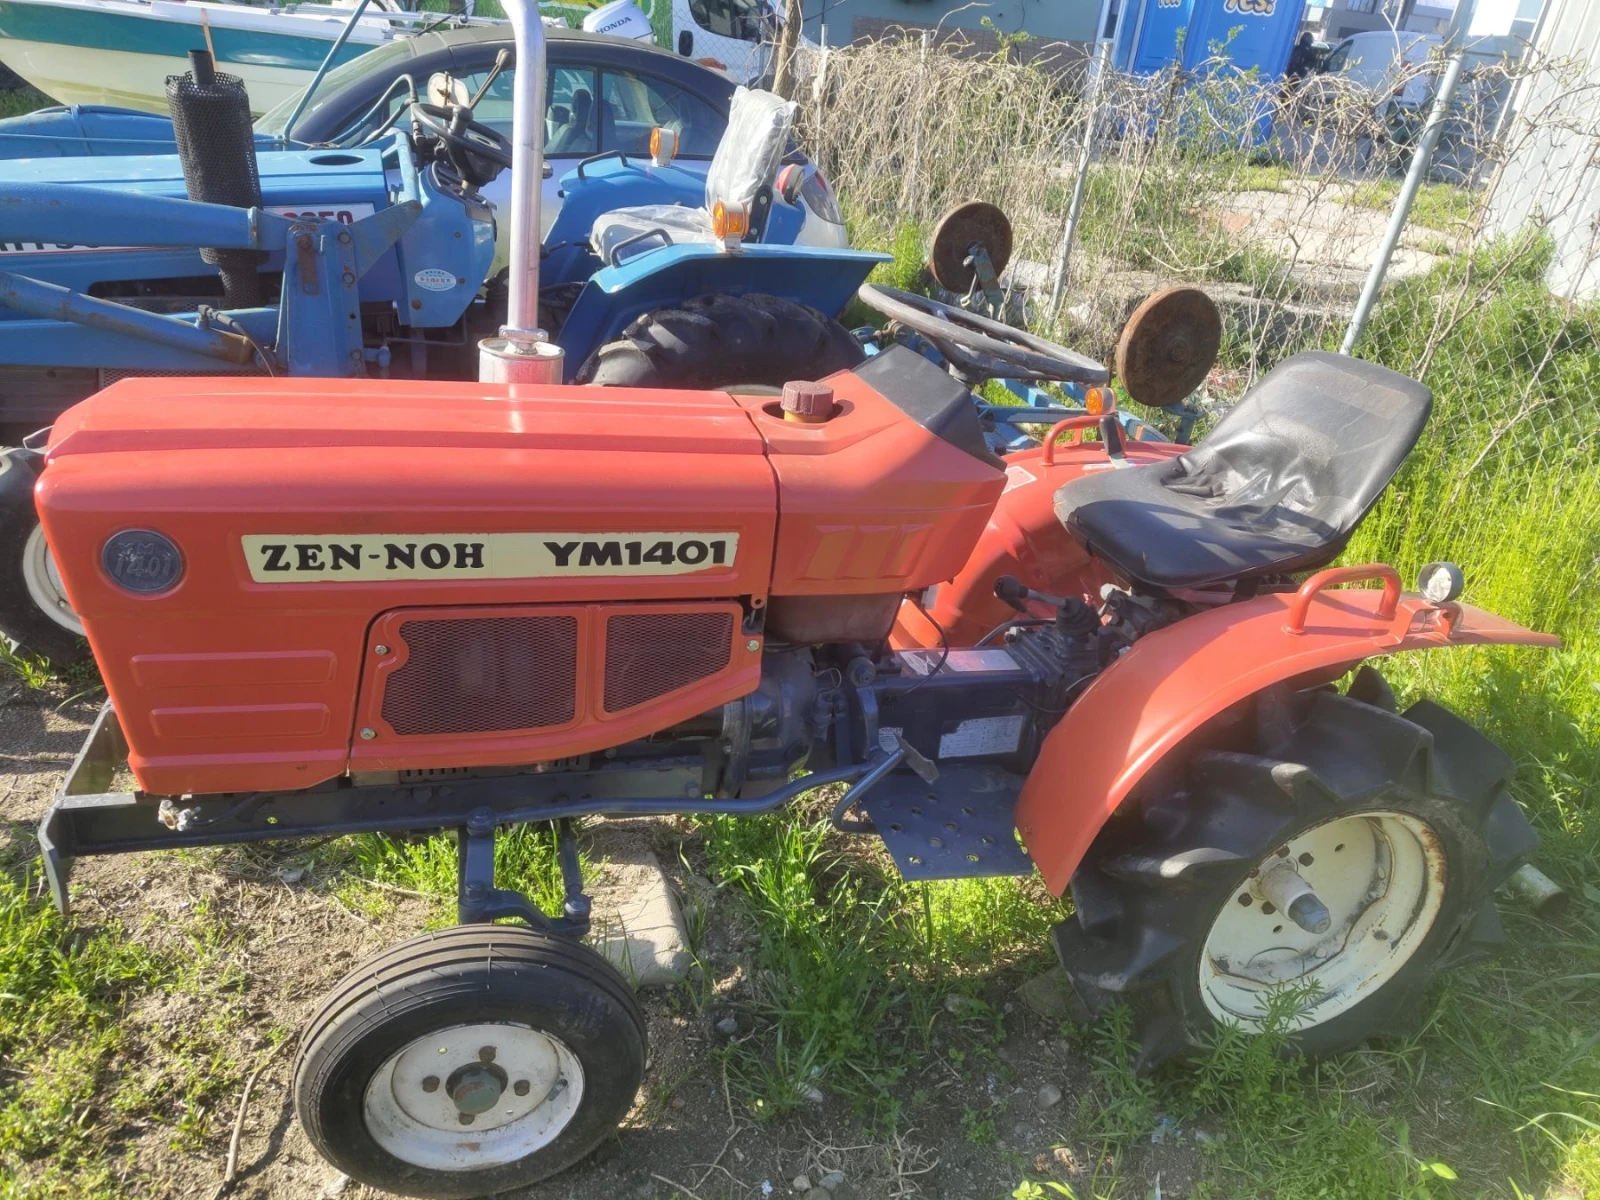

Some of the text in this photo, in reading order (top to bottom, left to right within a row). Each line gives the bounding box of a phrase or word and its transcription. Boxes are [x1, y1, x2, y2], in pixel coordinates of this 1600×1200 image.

[595, 16, 632, 34] HONDA
[115, 552, 172, 577] 1401
[260, 540, 726, 571] ZEN-NOH YM1401
